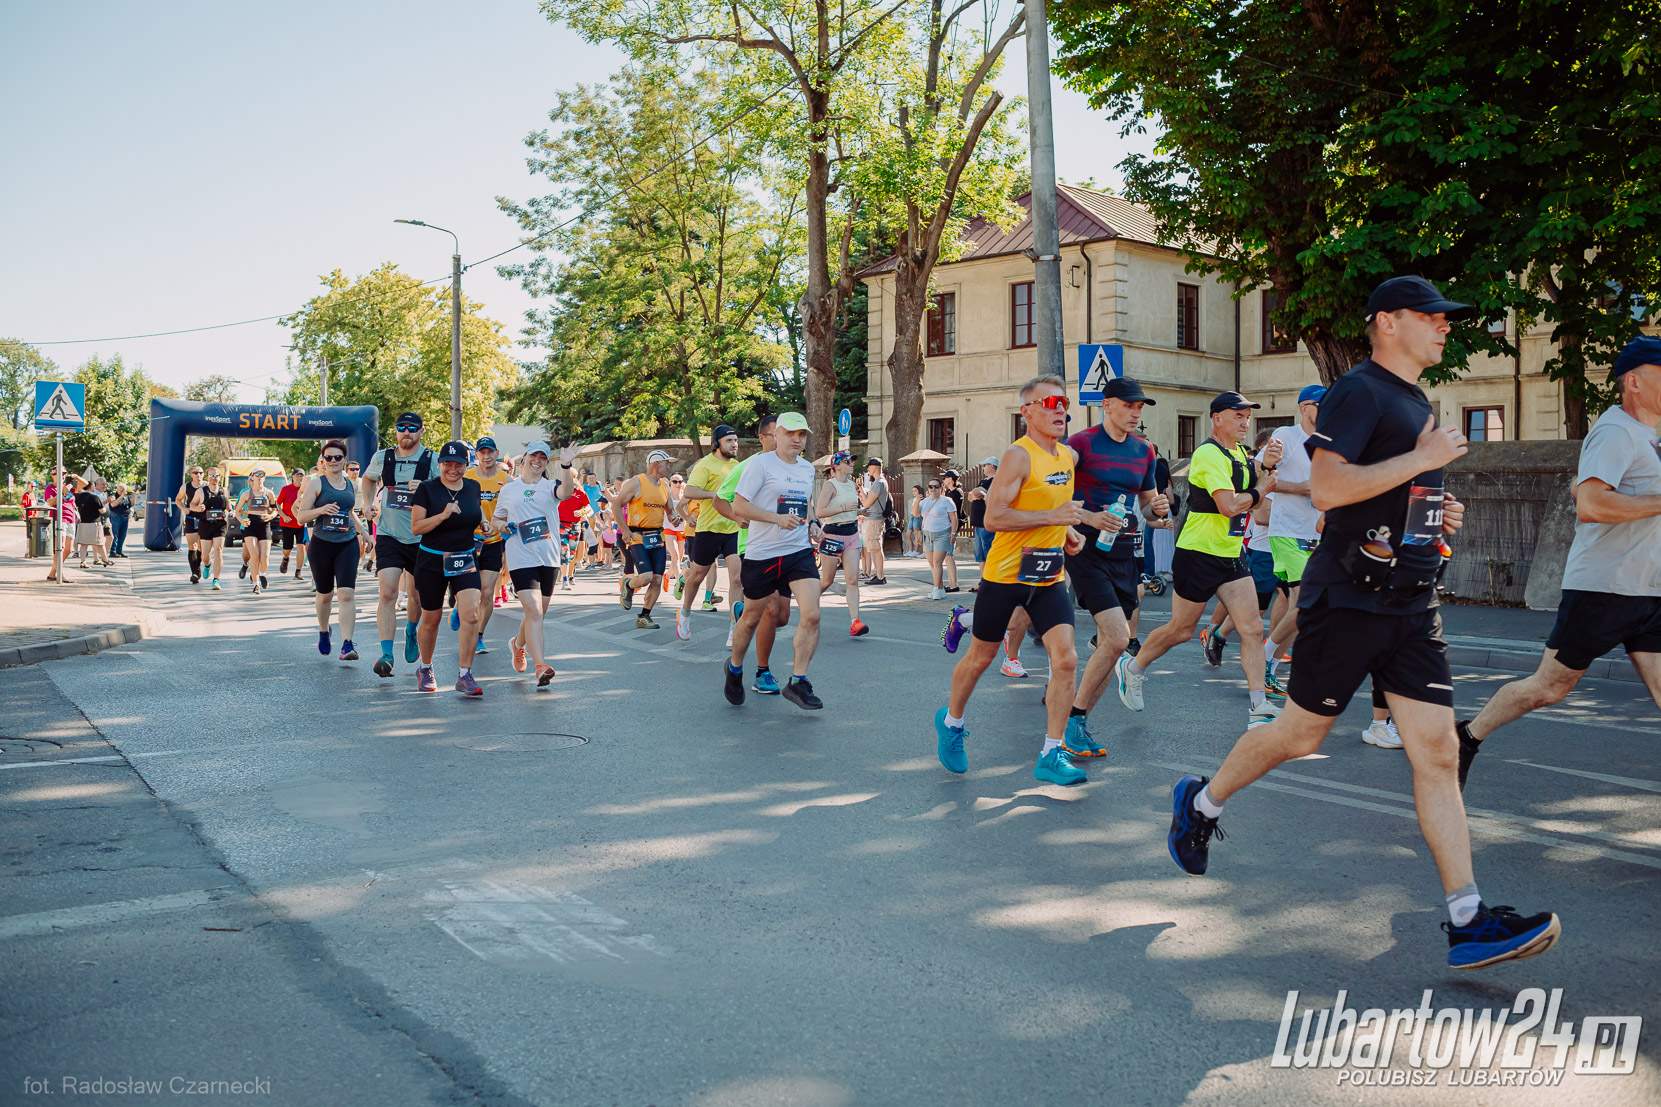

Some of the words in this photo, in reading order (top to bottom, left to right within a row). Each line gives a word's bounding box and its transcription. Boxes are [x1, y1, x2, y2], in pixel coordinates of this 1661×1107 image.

[239, 412, 302, 431] START
[396, 494, 408, 503] 92
[788, 507, 800, 516] 81
[330, 517, 344, 525] 134
[529, 525, 541, 534] 74
[453, 560, 465, 568] 80
[1035, 560, 1052, 572] 27
